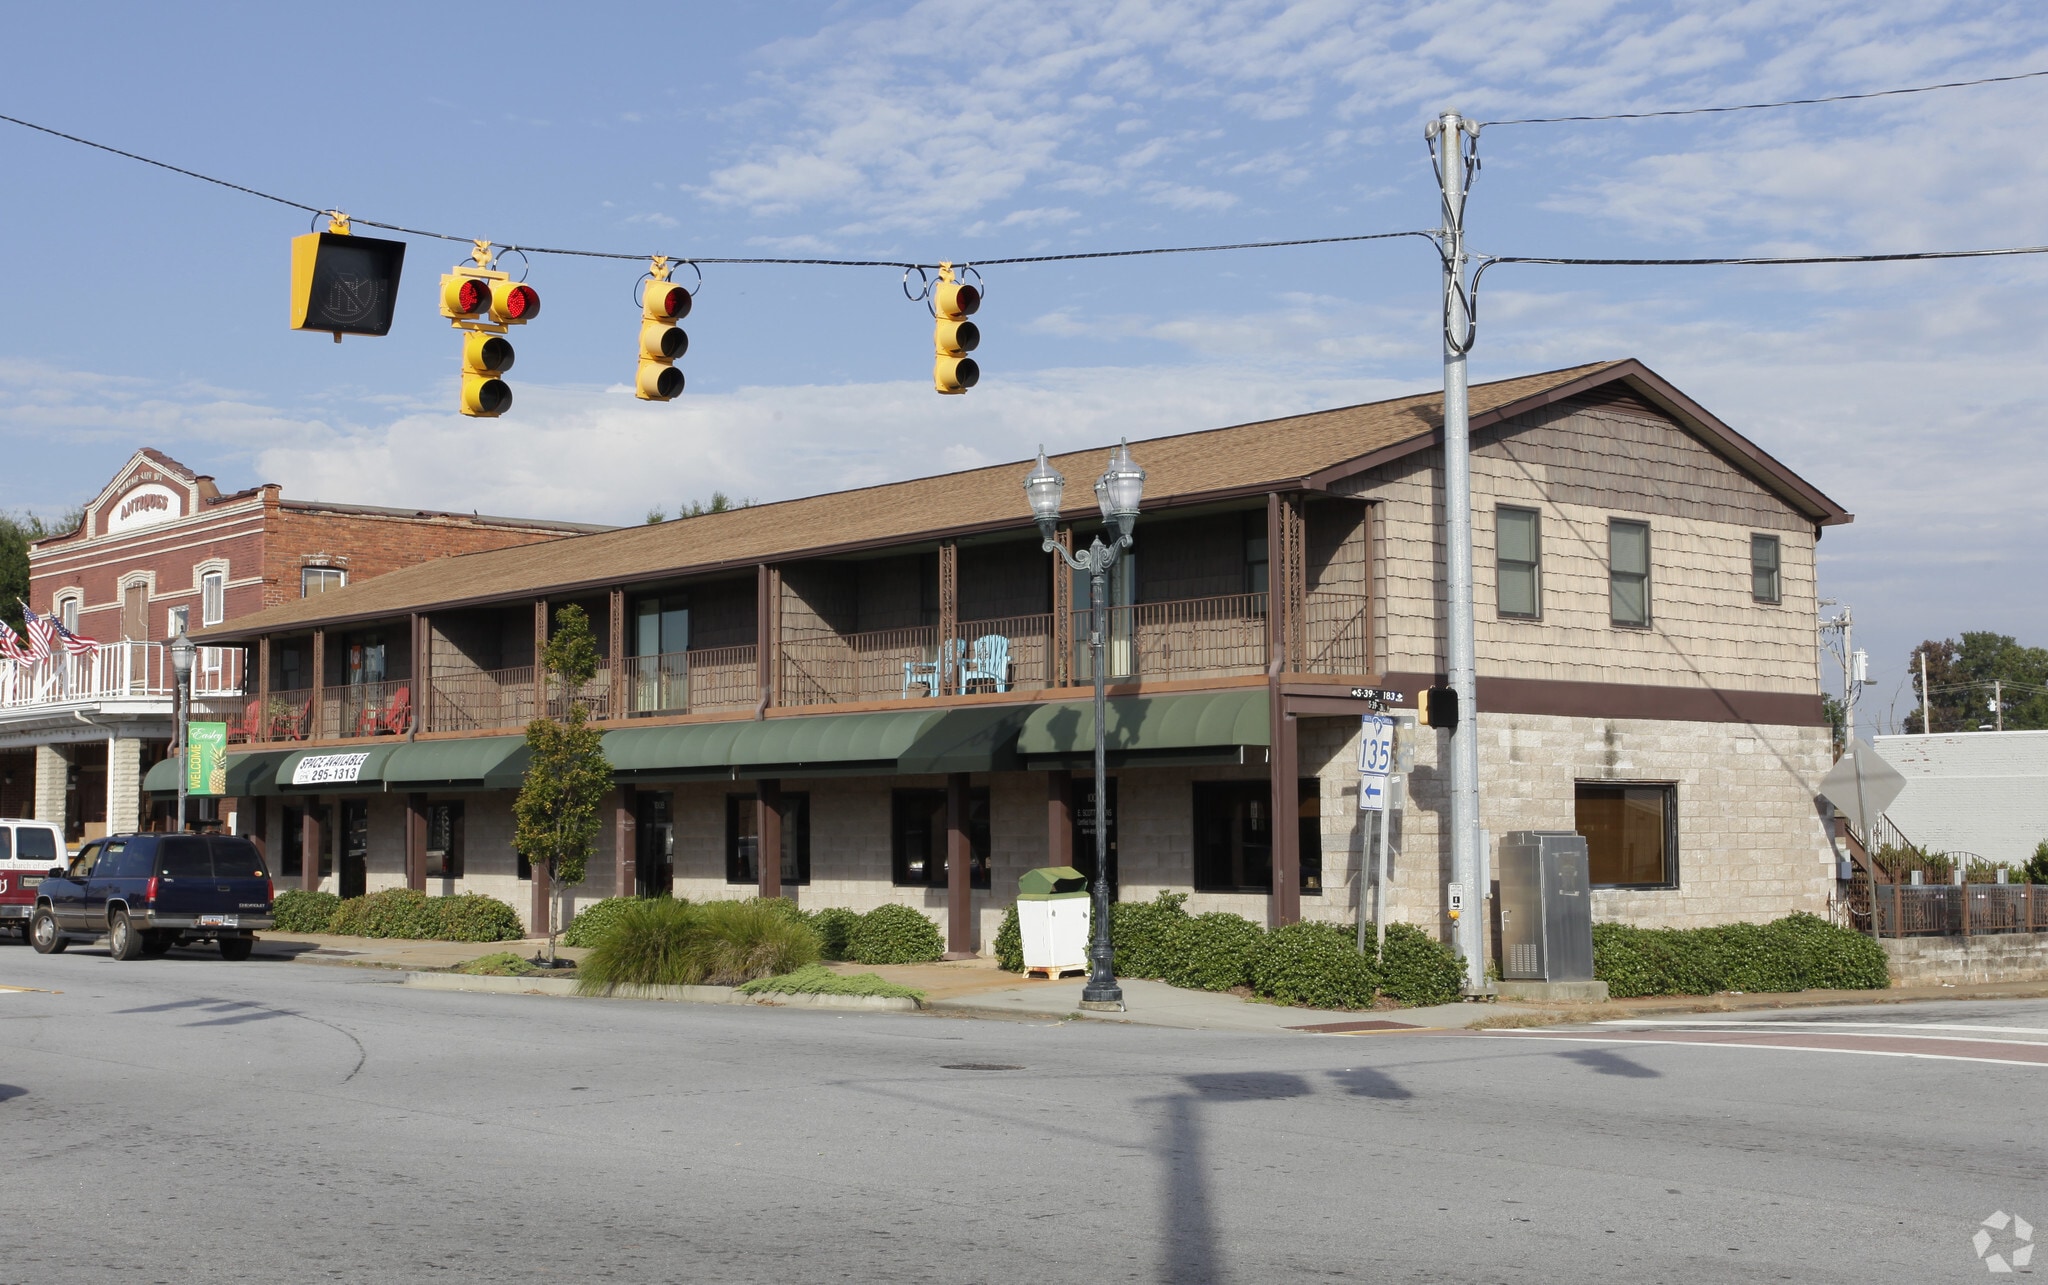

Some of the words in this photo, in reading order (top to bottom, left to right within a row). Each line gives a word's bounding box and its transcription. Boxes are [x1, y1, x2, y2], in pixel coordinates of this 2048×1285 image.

[120, 494, 168, 521] ANTIQUES
[189, 727, 224, 744] Easley
[300, 757, 327, 770] SPACE
[323, 754, 367, 768] AVAILABLE
[1362, 738, 1390, 770] 135
[190, 744, 202, 789] WELCOME
[311, 767, 357, 781] 295-1313
